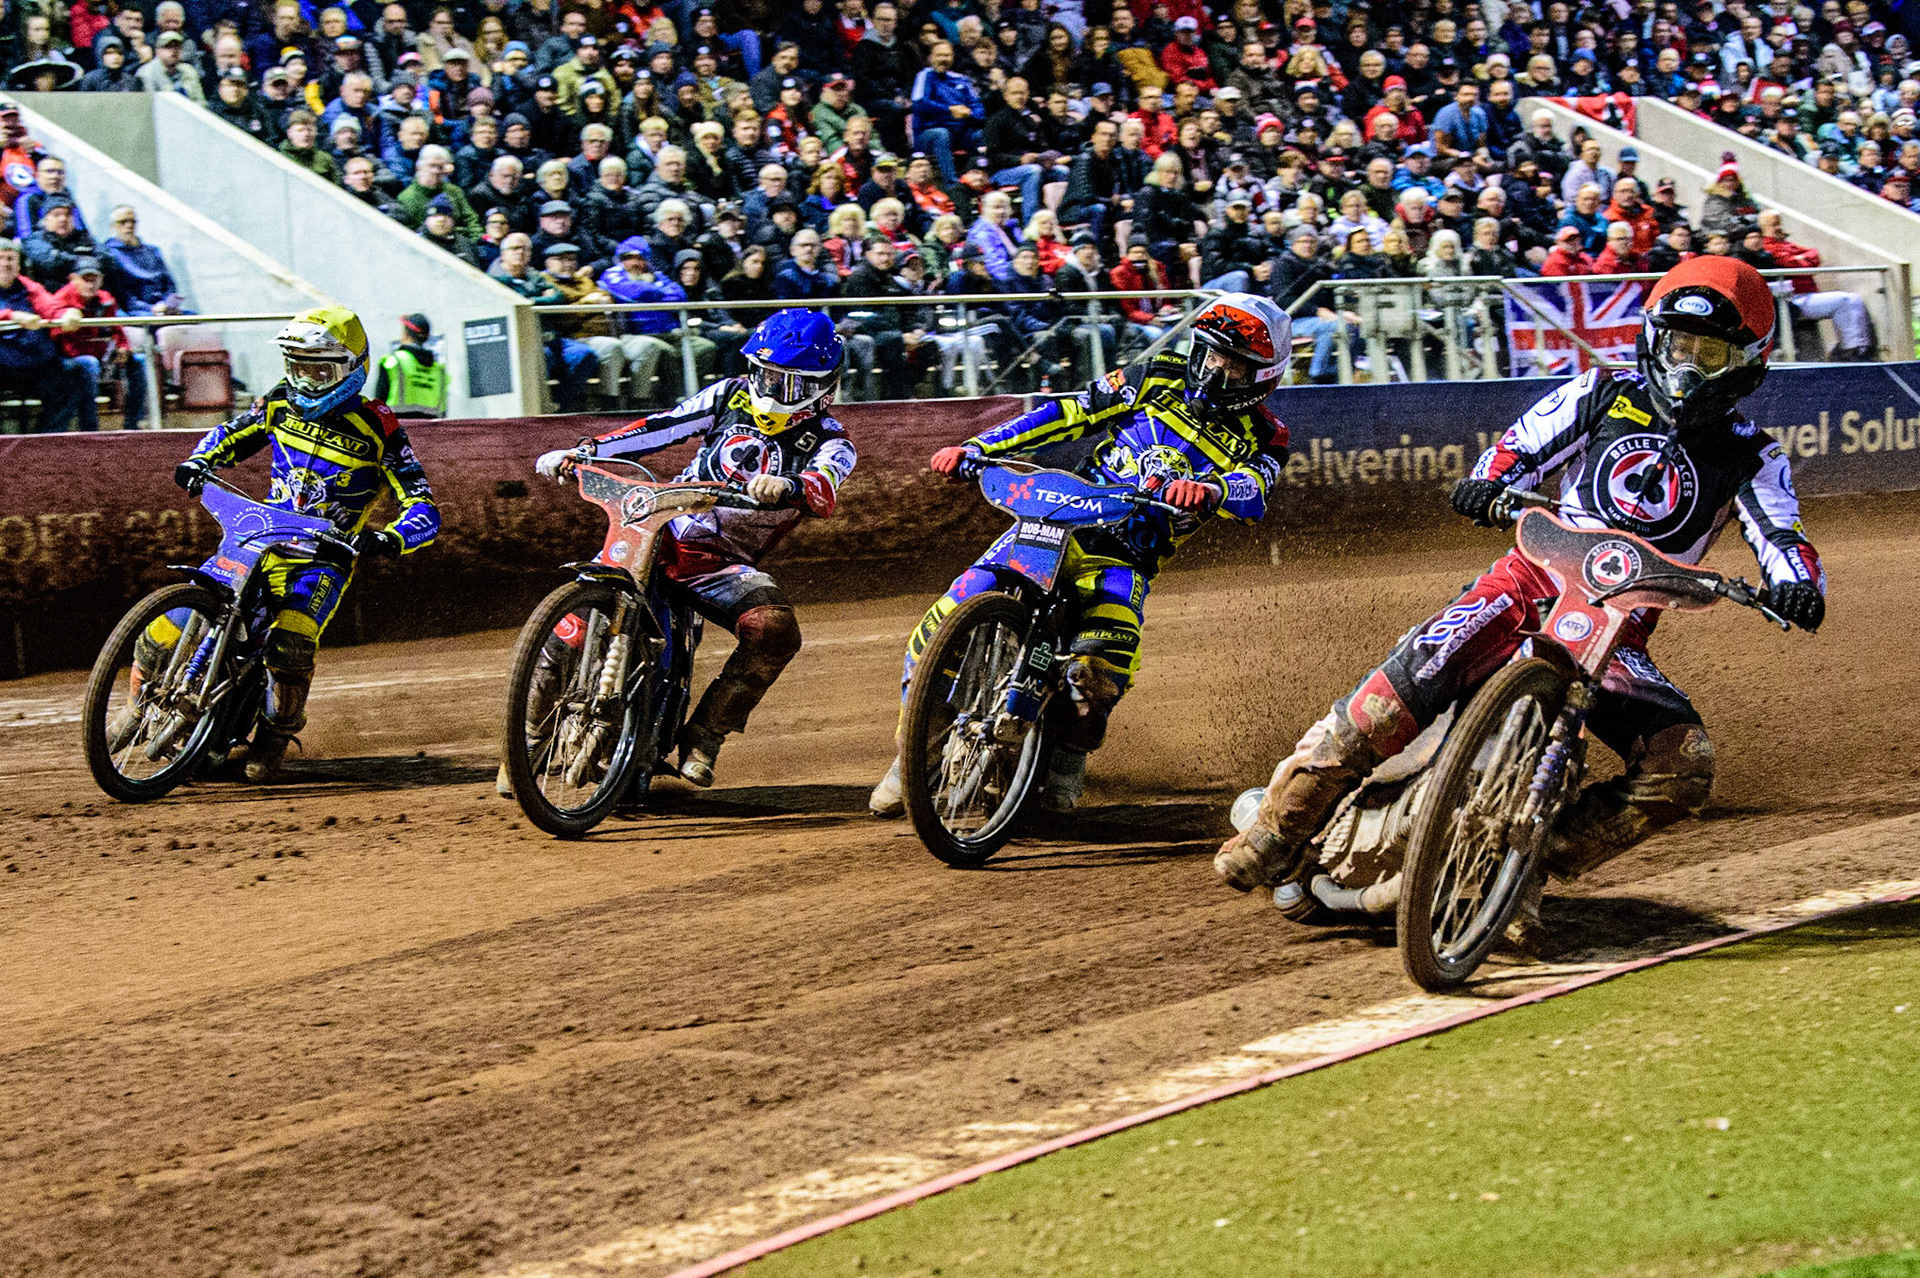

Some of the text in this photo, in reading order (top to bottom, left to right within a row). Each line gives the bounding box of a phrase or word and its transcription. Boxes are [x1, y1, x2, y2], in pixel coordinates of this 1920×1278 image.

[1610, 438, 1641, 460] BELLE
[1677, 464, 1694, 498] ACES
[336, 471, 351, 488] 3
[1035, 488, 1103, 514] TEXOM
[1020, 522, 1065, 541] ROB-MAN
[1562, 619, 1586, 633] ATPI
